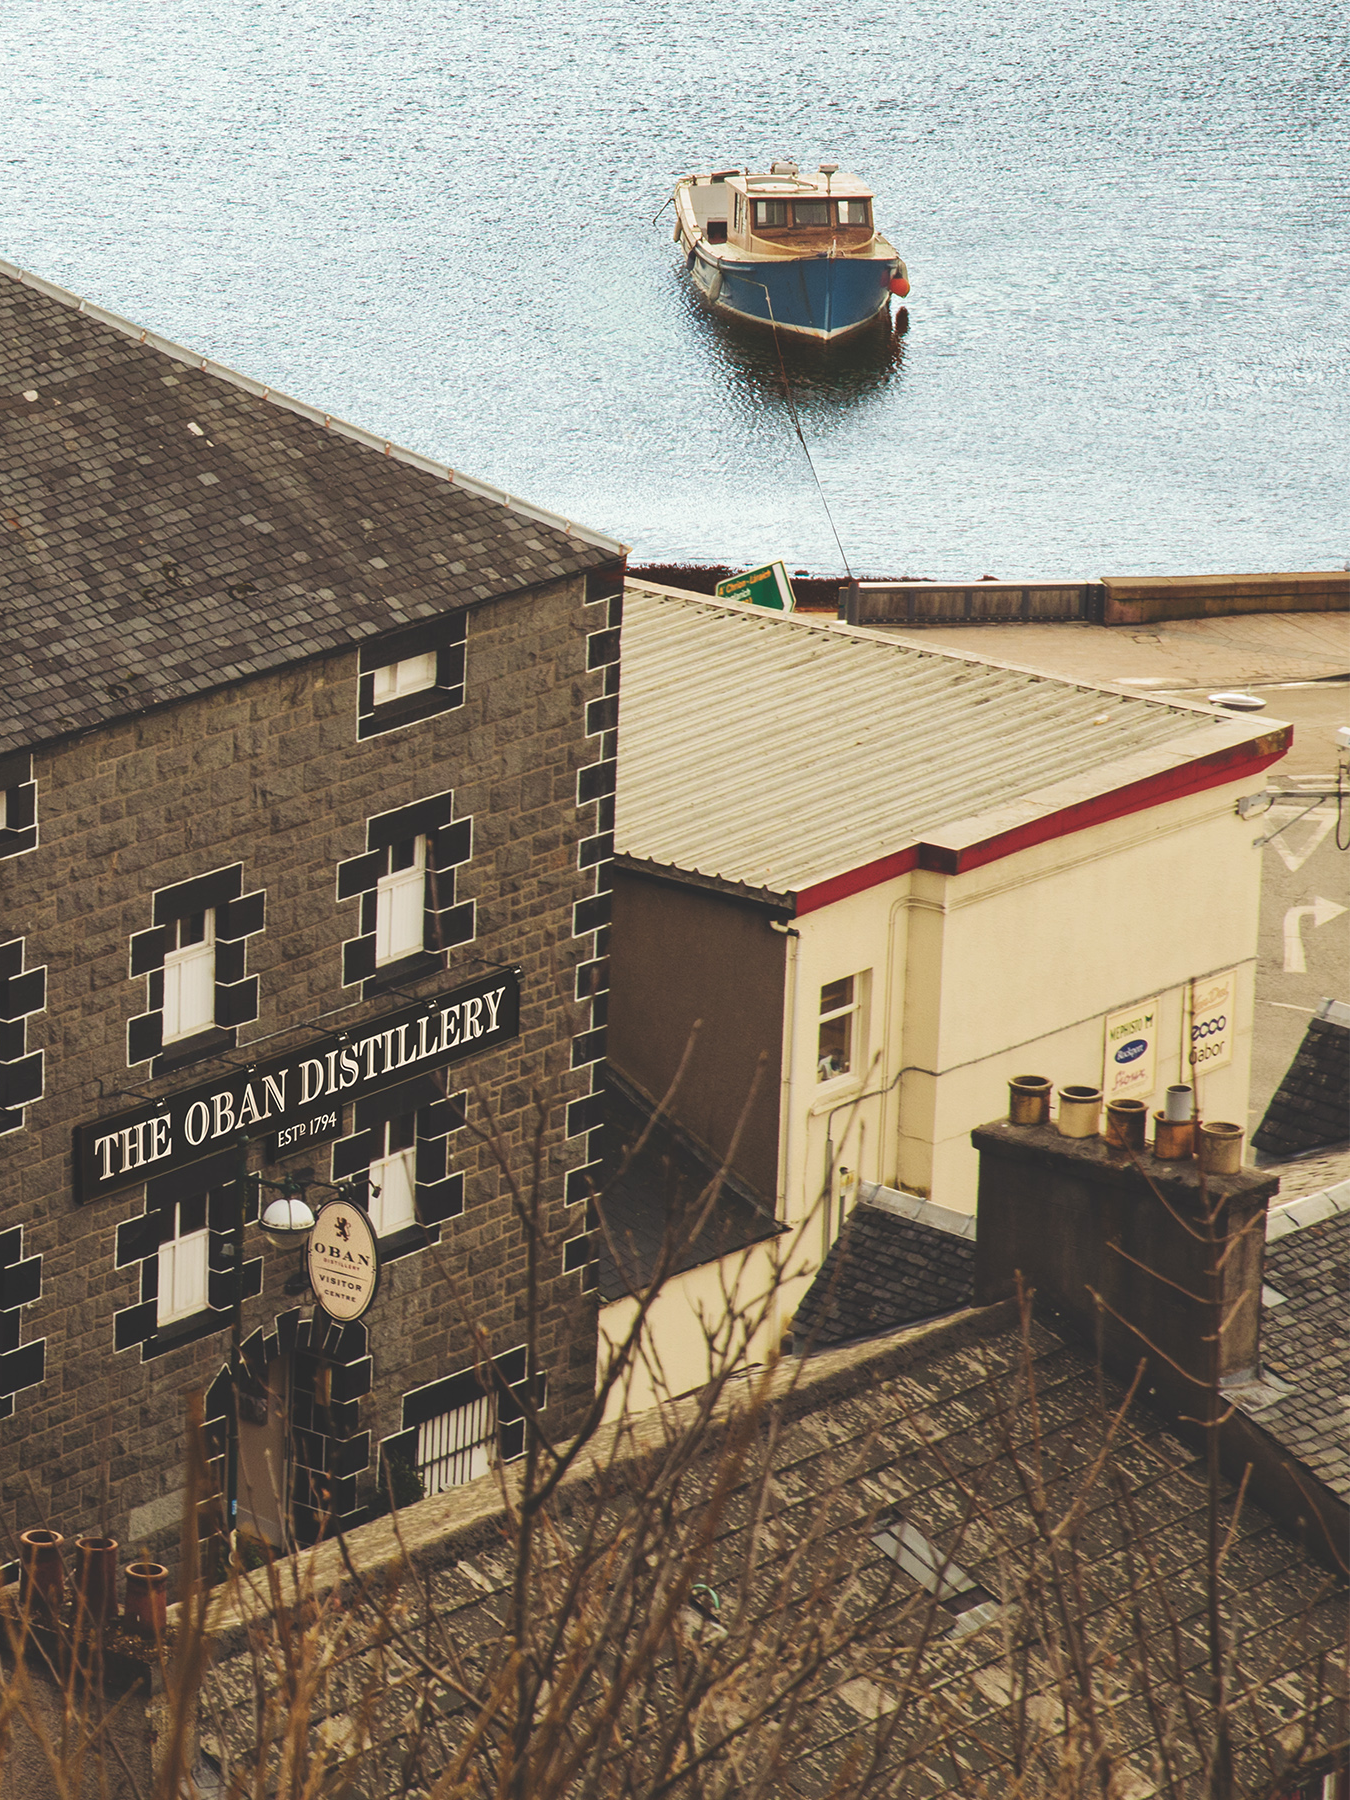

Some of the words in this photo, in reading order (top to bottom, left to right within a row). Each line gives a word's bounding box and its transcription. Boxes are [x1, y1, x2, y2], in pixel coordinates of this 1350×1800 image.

[1109, 1018, 1143, 1041] MEPHISTO
[1190, 1015, 1227, 1042] ecco
[1189, 1040, 1225, 1066] Gabor
[94, 1113, 173, 1181] THE
[184, 1069, 289, 1146] OBAN
[298, 987, 506, 1105] DISTILLERY
[309, 1111, 337, 1136] 1794
[314, 1242, 370, 1266] OBAN
[323, 1257, 360, 1272] DISTILLERY
[319, 1274, 362, 1292] VISITOR
[324, 1289, 356, 1303] CENTRE
